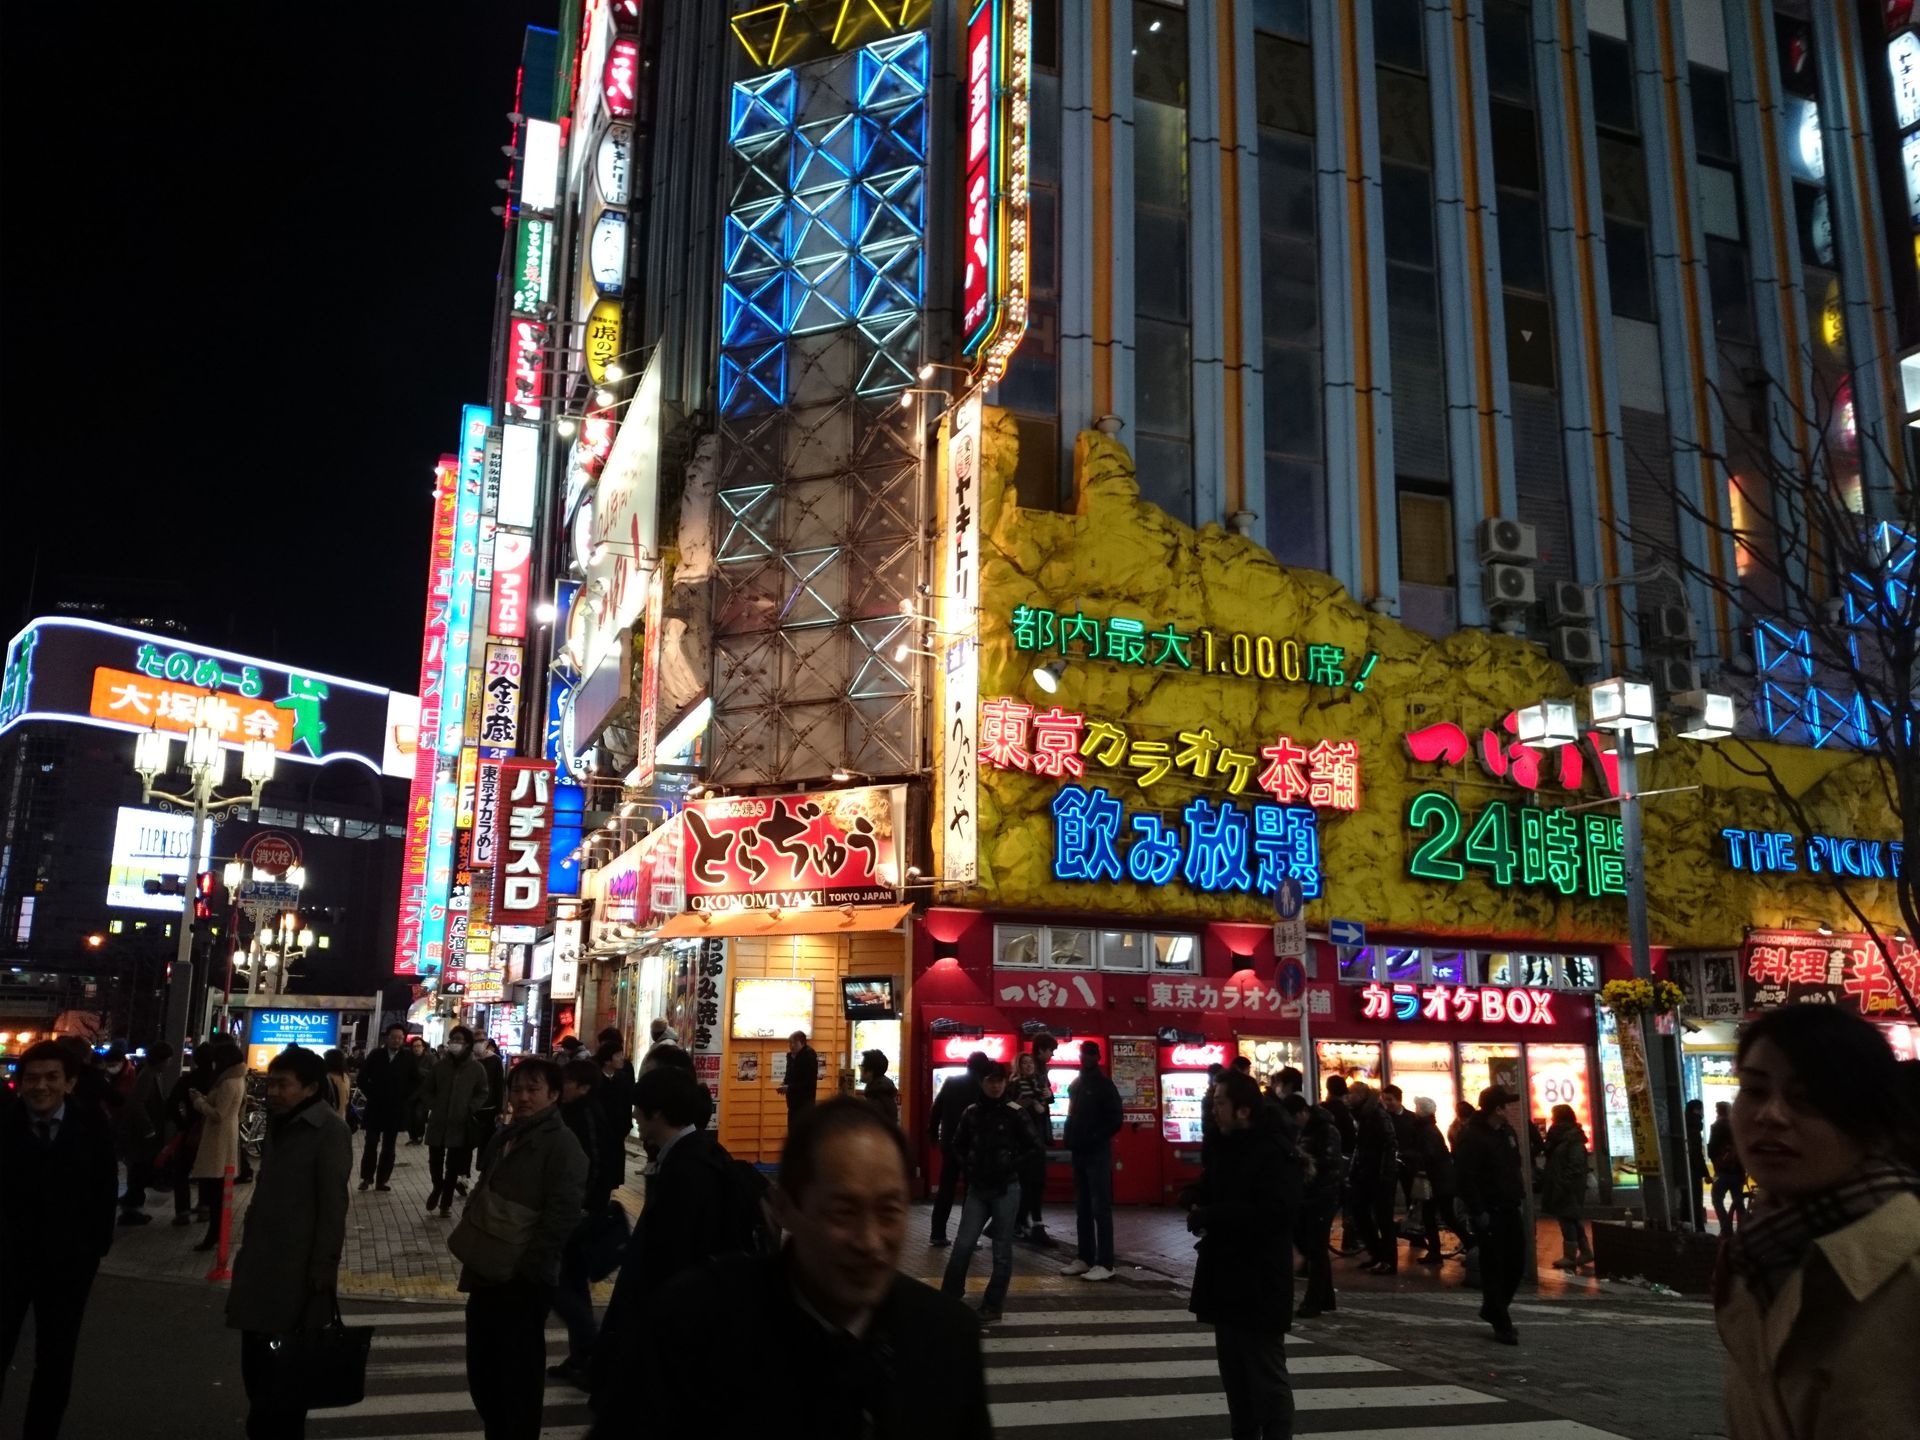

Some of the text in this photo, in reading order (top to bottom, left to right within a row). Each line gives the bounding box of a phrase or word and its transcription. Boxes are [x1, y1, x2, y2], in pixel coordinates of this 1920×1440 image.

[499, 573, 521, 620] アコム
[137, 643, 263, 698] たのめーる
[489, 660, 521, 677] 270
[482, 676, 520, 742] 金の蔵
[977, 696, 1361, 811] 東京カラオケ本舗
[476, 764, 499, 861] 東京チカラめし
[256, 849, 291, 866] 消火栓
[503, 769, 550, 910] パチスロ
[1053, 784, 1323, 899] 飲み放題
[1409, 792, 1627, 897] 24時間
[1722, 828, 1798, 872] THE
[1806, 835, 1885, 878] PICK
[829, 893, 860, 902] TOKYO
[862, 891, 892, 901] JAPAN
[1748, 946, 1828, 984] 料理
[1826, 950, 1846, 985] 全品
[1000, 975, 1097, 1008] つぼ八
[1150, 982, 1332, 1015] 東京カラオケ舗
[1362, 983, 1557, 1025] カラオケBOX
[1706, 1003, 1741, 1016] 虎の子
[261, 1013, 330, 1027] SUBNADE
[256, 1050, 269, 1067] 5
